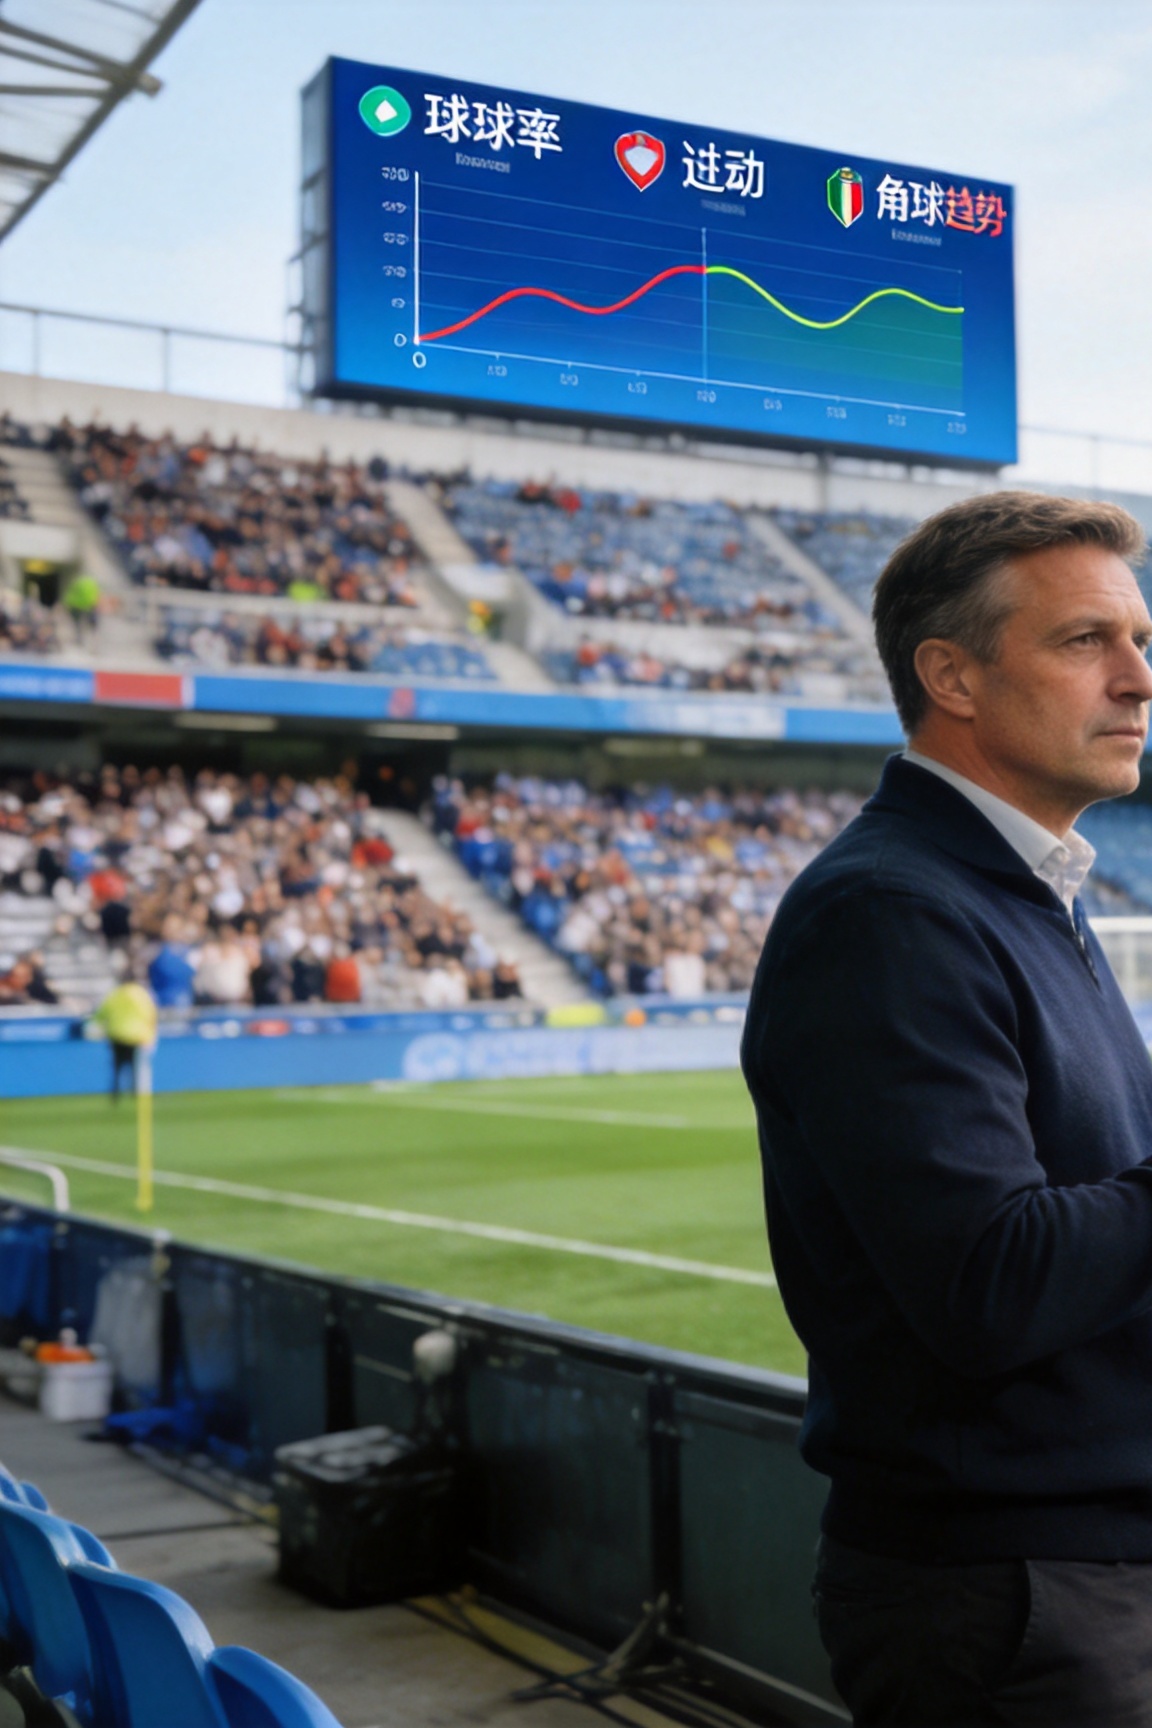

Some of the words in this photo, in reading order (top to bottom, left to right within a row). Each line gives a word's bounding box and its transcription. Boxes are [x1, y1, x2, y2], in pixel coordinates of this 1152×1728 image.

[424, 93, 563, 160] 球球率
[412, 351, 427, 368] 0
